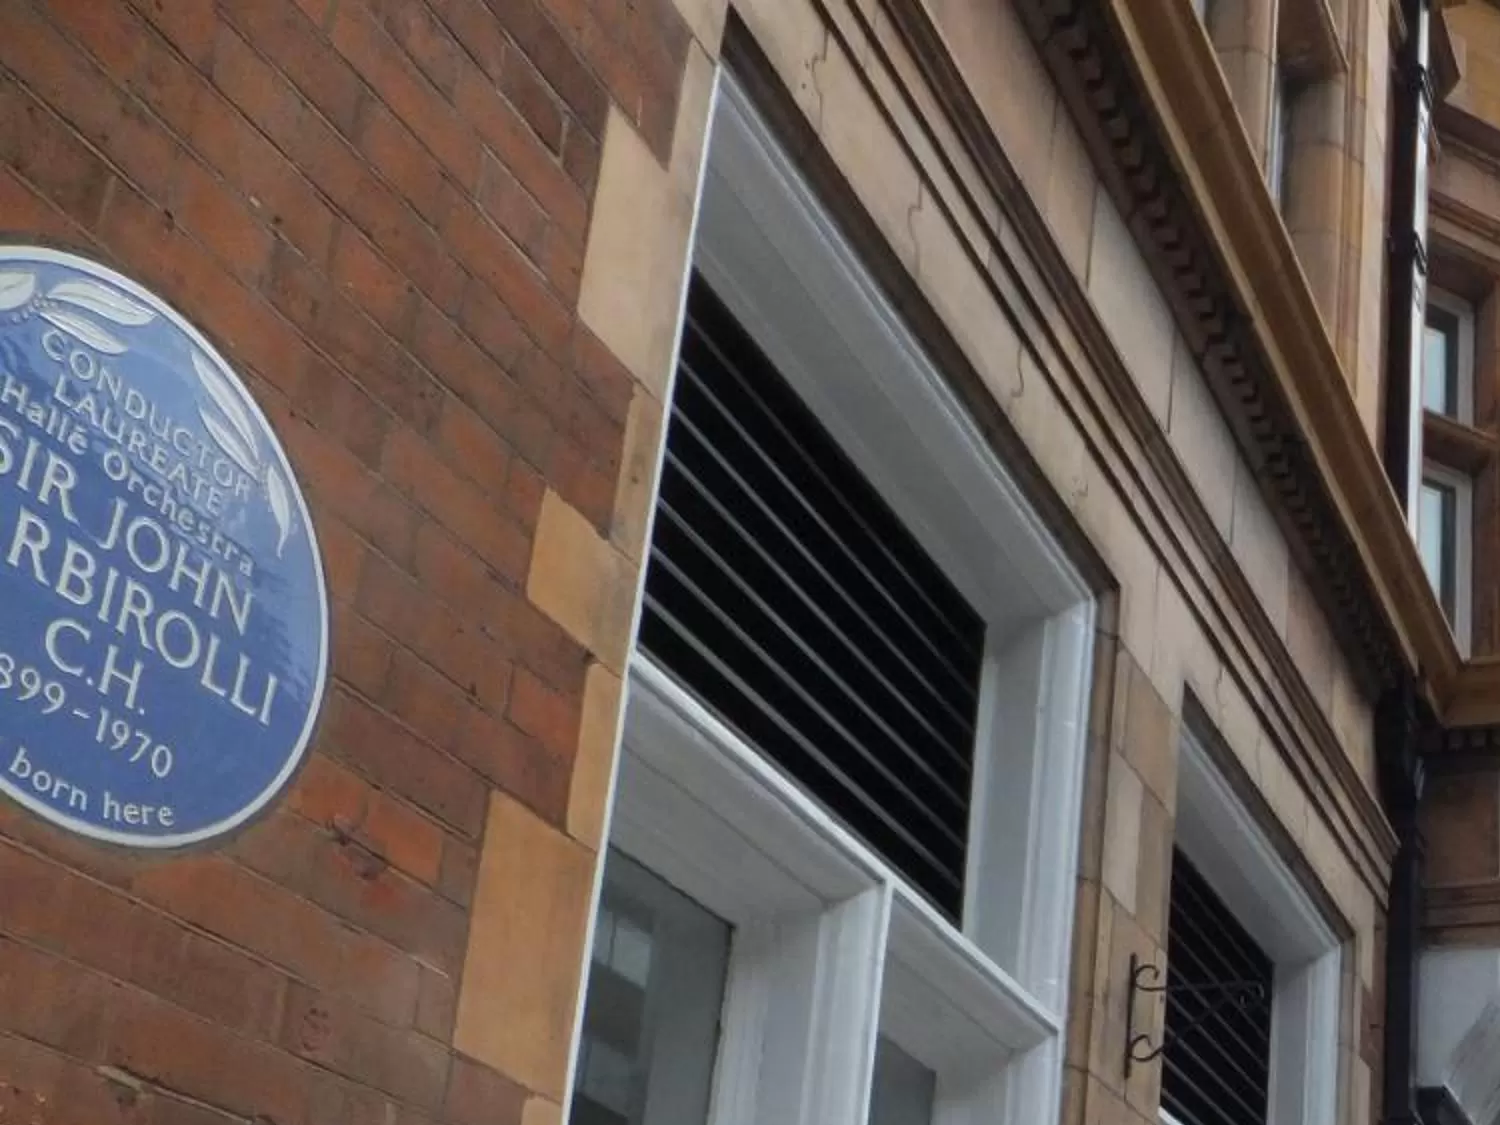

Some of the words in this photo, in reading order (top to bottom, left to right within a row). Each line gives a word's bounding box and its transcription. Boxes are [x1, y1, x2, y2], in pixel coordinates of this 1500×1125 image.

[42, 329, 251, 502] CONDUCTOR
[54, 374, 226, 516] LAUREATE
[0, 416, 80, 527] SIR
[96, 497, 256, 636] JOHN
[103, 450, 253, 576] Orchestra
[45, 618, 145, 716] C.H.
[8, 747, 88, 802] born
[102, 792, 175, 827] here
